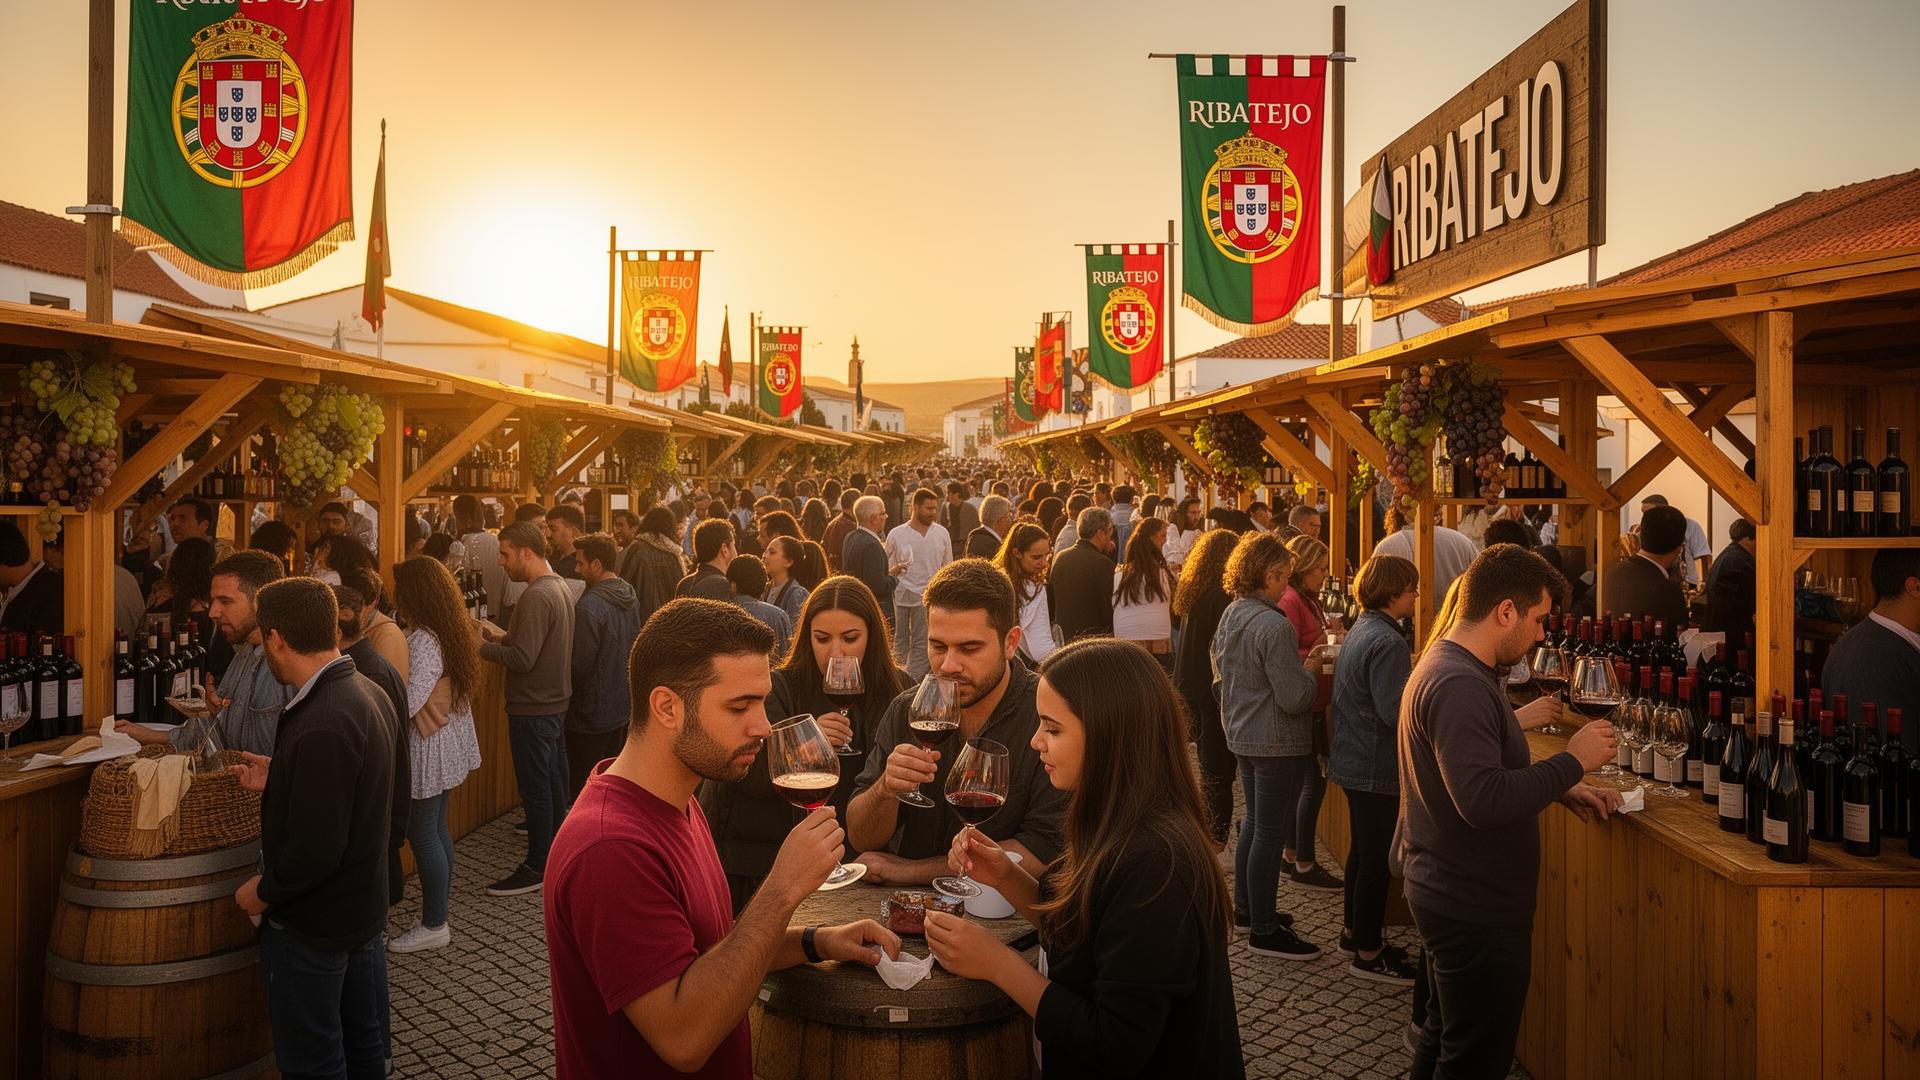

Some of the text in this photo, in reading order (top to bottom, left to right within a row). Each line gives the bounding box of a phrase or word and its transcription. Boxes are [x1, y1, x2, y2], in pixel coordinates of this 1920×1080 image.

[1188, 100, 1312, 130] RIBATEJO
[1392, 60, 1563, 271] RIBATEJO
[628, 276, 693, 290] RIBATEJO
[1092, 270, 1159, 286] RIBATEJO
